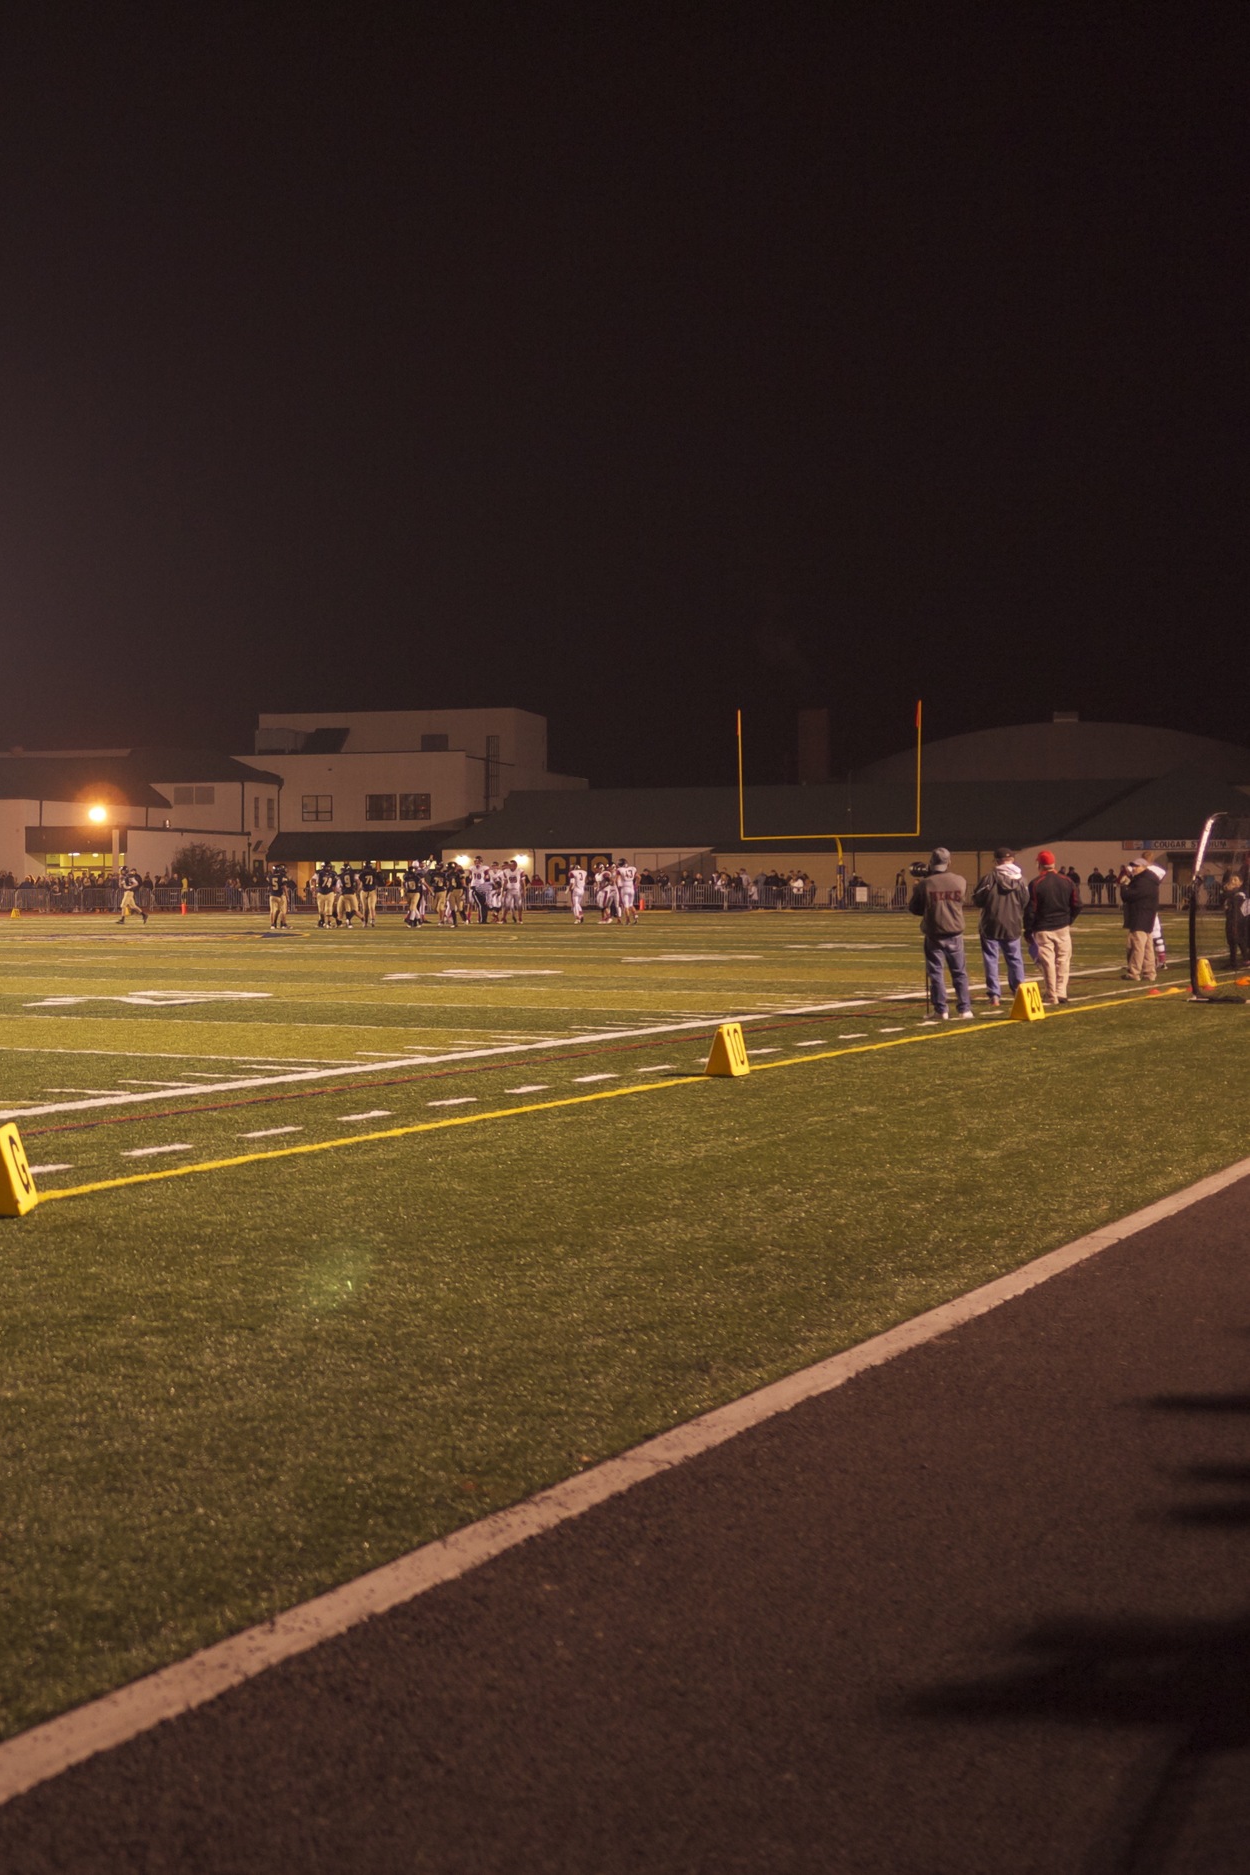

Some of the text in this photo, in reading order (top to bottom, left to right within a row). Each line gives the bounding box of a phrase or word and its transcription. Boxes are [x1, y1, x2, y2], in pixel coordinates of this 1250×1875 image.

[1153, 841, 1187, 849] COUGAR
[271, 877, 279, 891] 5
[344, 875, 351, 888] 9
[1026, 986, 1041, 1013] 20
[726, 1026, 746, 1067] 10
[7, 1134, 33, 1195] G
